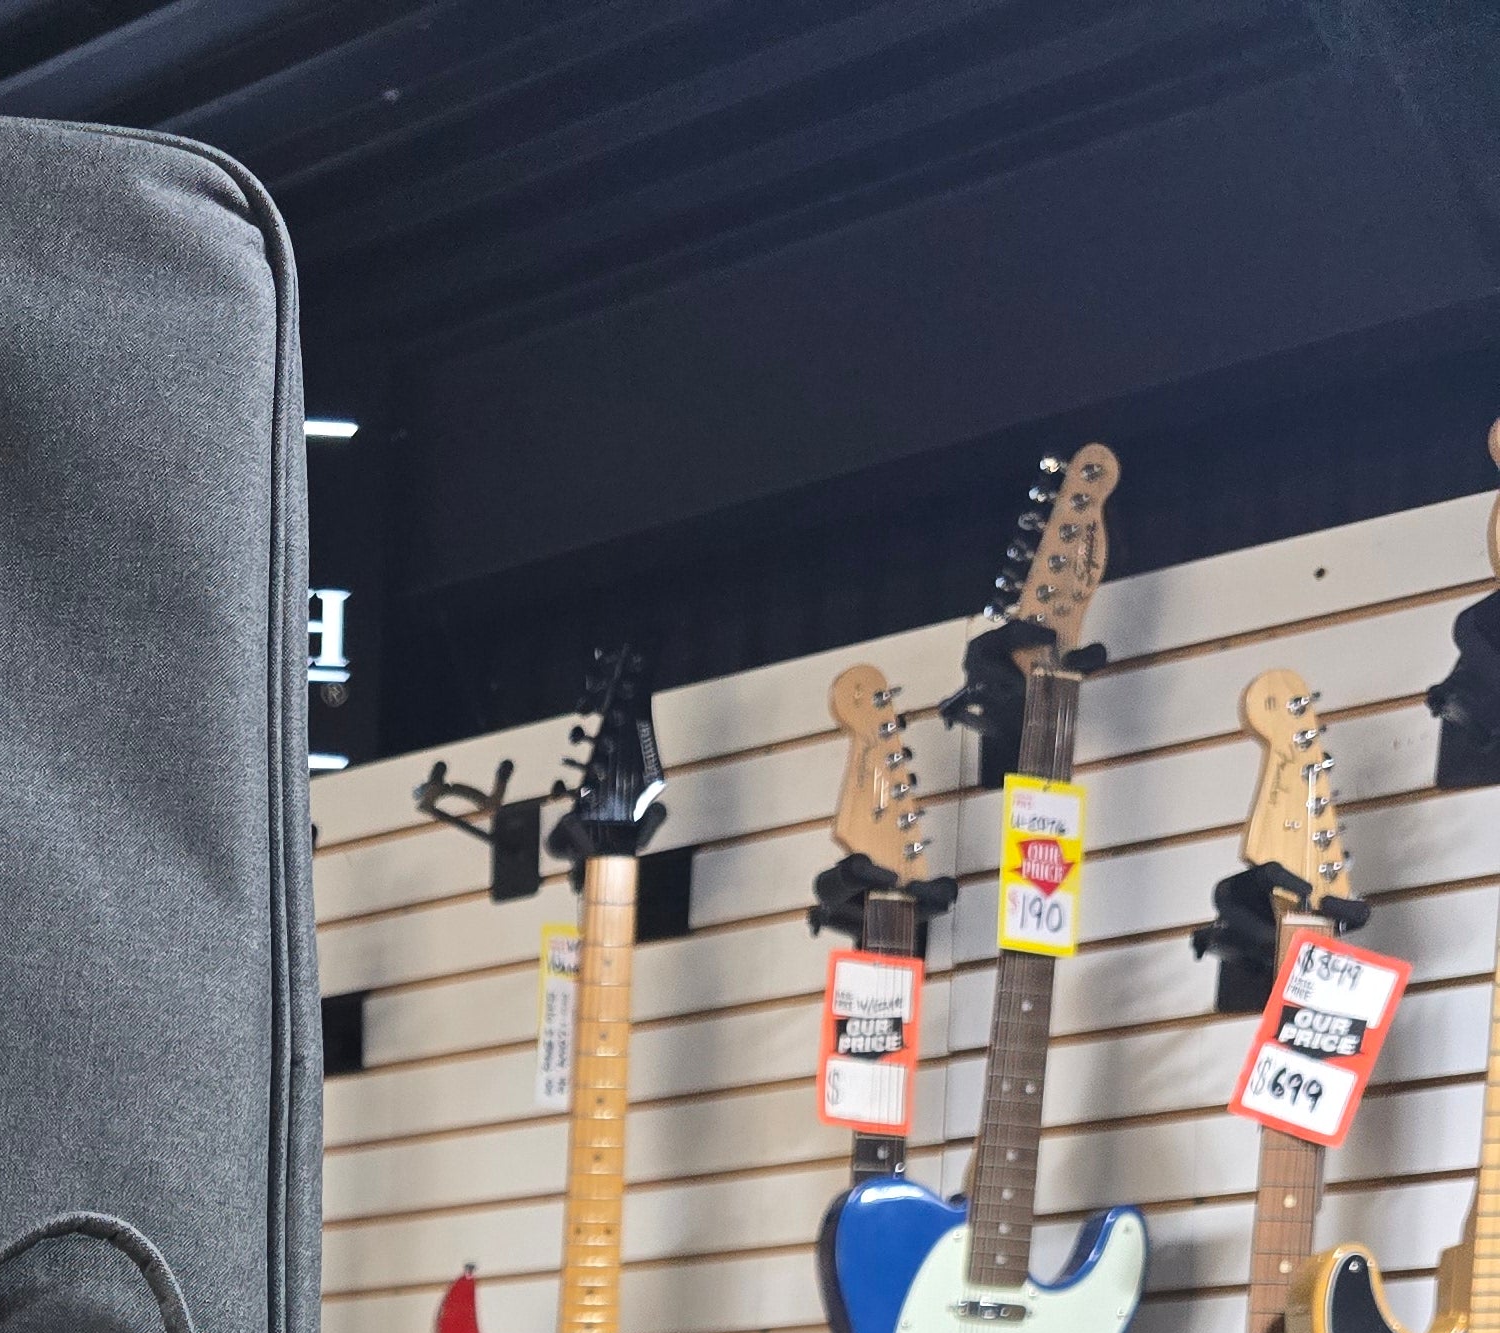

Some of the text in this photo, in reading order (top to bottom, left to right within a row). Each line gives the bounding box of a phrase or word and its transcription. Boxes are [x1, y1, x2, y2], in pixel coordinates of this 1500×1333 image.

[1027, 843, 1061, 862] OUR
[1021, 860, 1064, 883] PRICE
[846, 1017, 894, 1037] OUR
[1293, 1008, 1355, 1035] OUR
[837, 1034, 904, 1054] PRICE
[1276, 1021, 1361, 1056] PRICE
